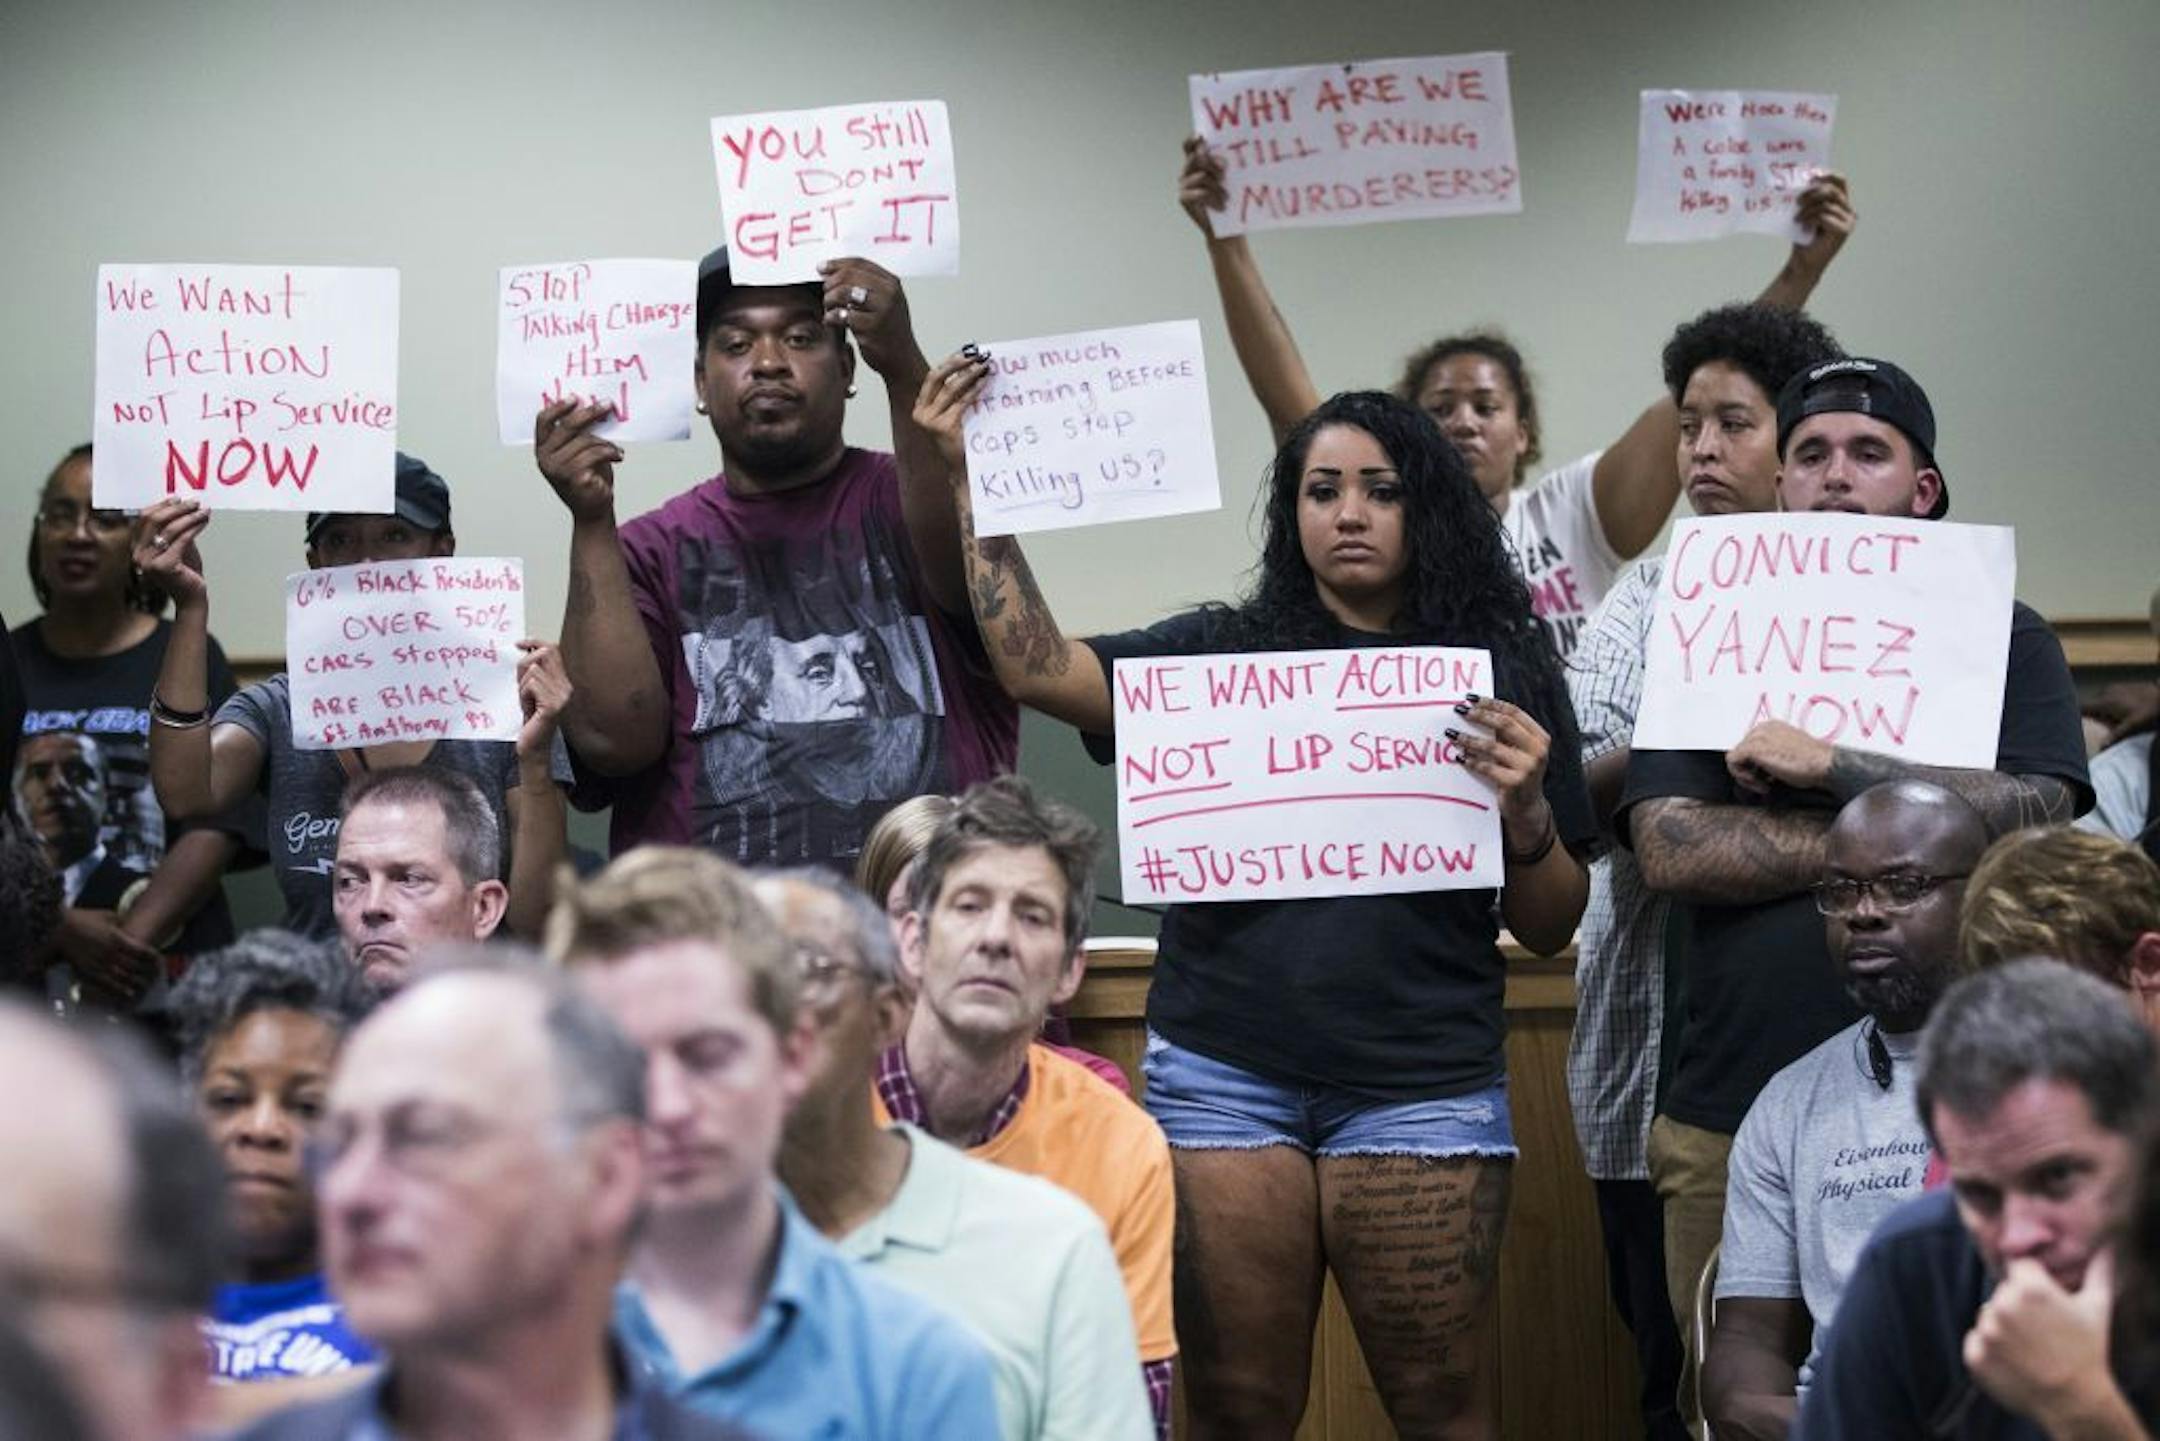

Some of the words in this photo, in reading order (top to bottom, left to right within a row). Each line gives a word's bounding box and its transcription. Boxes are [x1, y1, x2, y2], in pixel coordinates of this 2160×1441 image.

[1203, 86, 1297, 131] WHY
[1316, 74, 1405, 113] ARE
[1417, 70, 1490, 102] WE
[1333, 118, 1479, 150] PAYING
[723, 126, 827, 188] YOU
[795, 158, 924, 196] DONT
[1240, 164, 1517, 224] MURDERERS?
[736, 200, 853, 261] GET
[874, 195, 949, 245] IT
[108, 280, 154, 311] We
[506, 263, 591, 307] STOP
[567, 344, 647, 381] HIM
[987, 356, 1029, 377] ow
[1039, 341, 1121, 370] much
[1107, 359, 1193, 392] BEFORE
[201, 392, 257, 432] Lip
[273, 391, 396, 431] Service
[541, 377, 629, 422] NW
[166, 437, 319, 493] NOW
[1672, 529, 1921, 600] CONVICT
[297, 574, 335, 607] 6%
[343, 611, 440, 640] OVER
[455, 603, 511, 633] 50%
[304, 652, 374, 674] CARS
[1671, 604, 1916, 683] YANEZ
[1118, 665, 1191, 713] WE
[1208, 661, 1326, 709] WANT
[1337, 653, 1480, 699] ACTION
[311, 697, 359, 717] ARE
[1126, 739, 1231, 787] NOT
[1267, 734, 1333, 775] LIP
[1348, 731, 1462, 773] SERVIC
[1818, 1167, 1912, 1201] Physical
